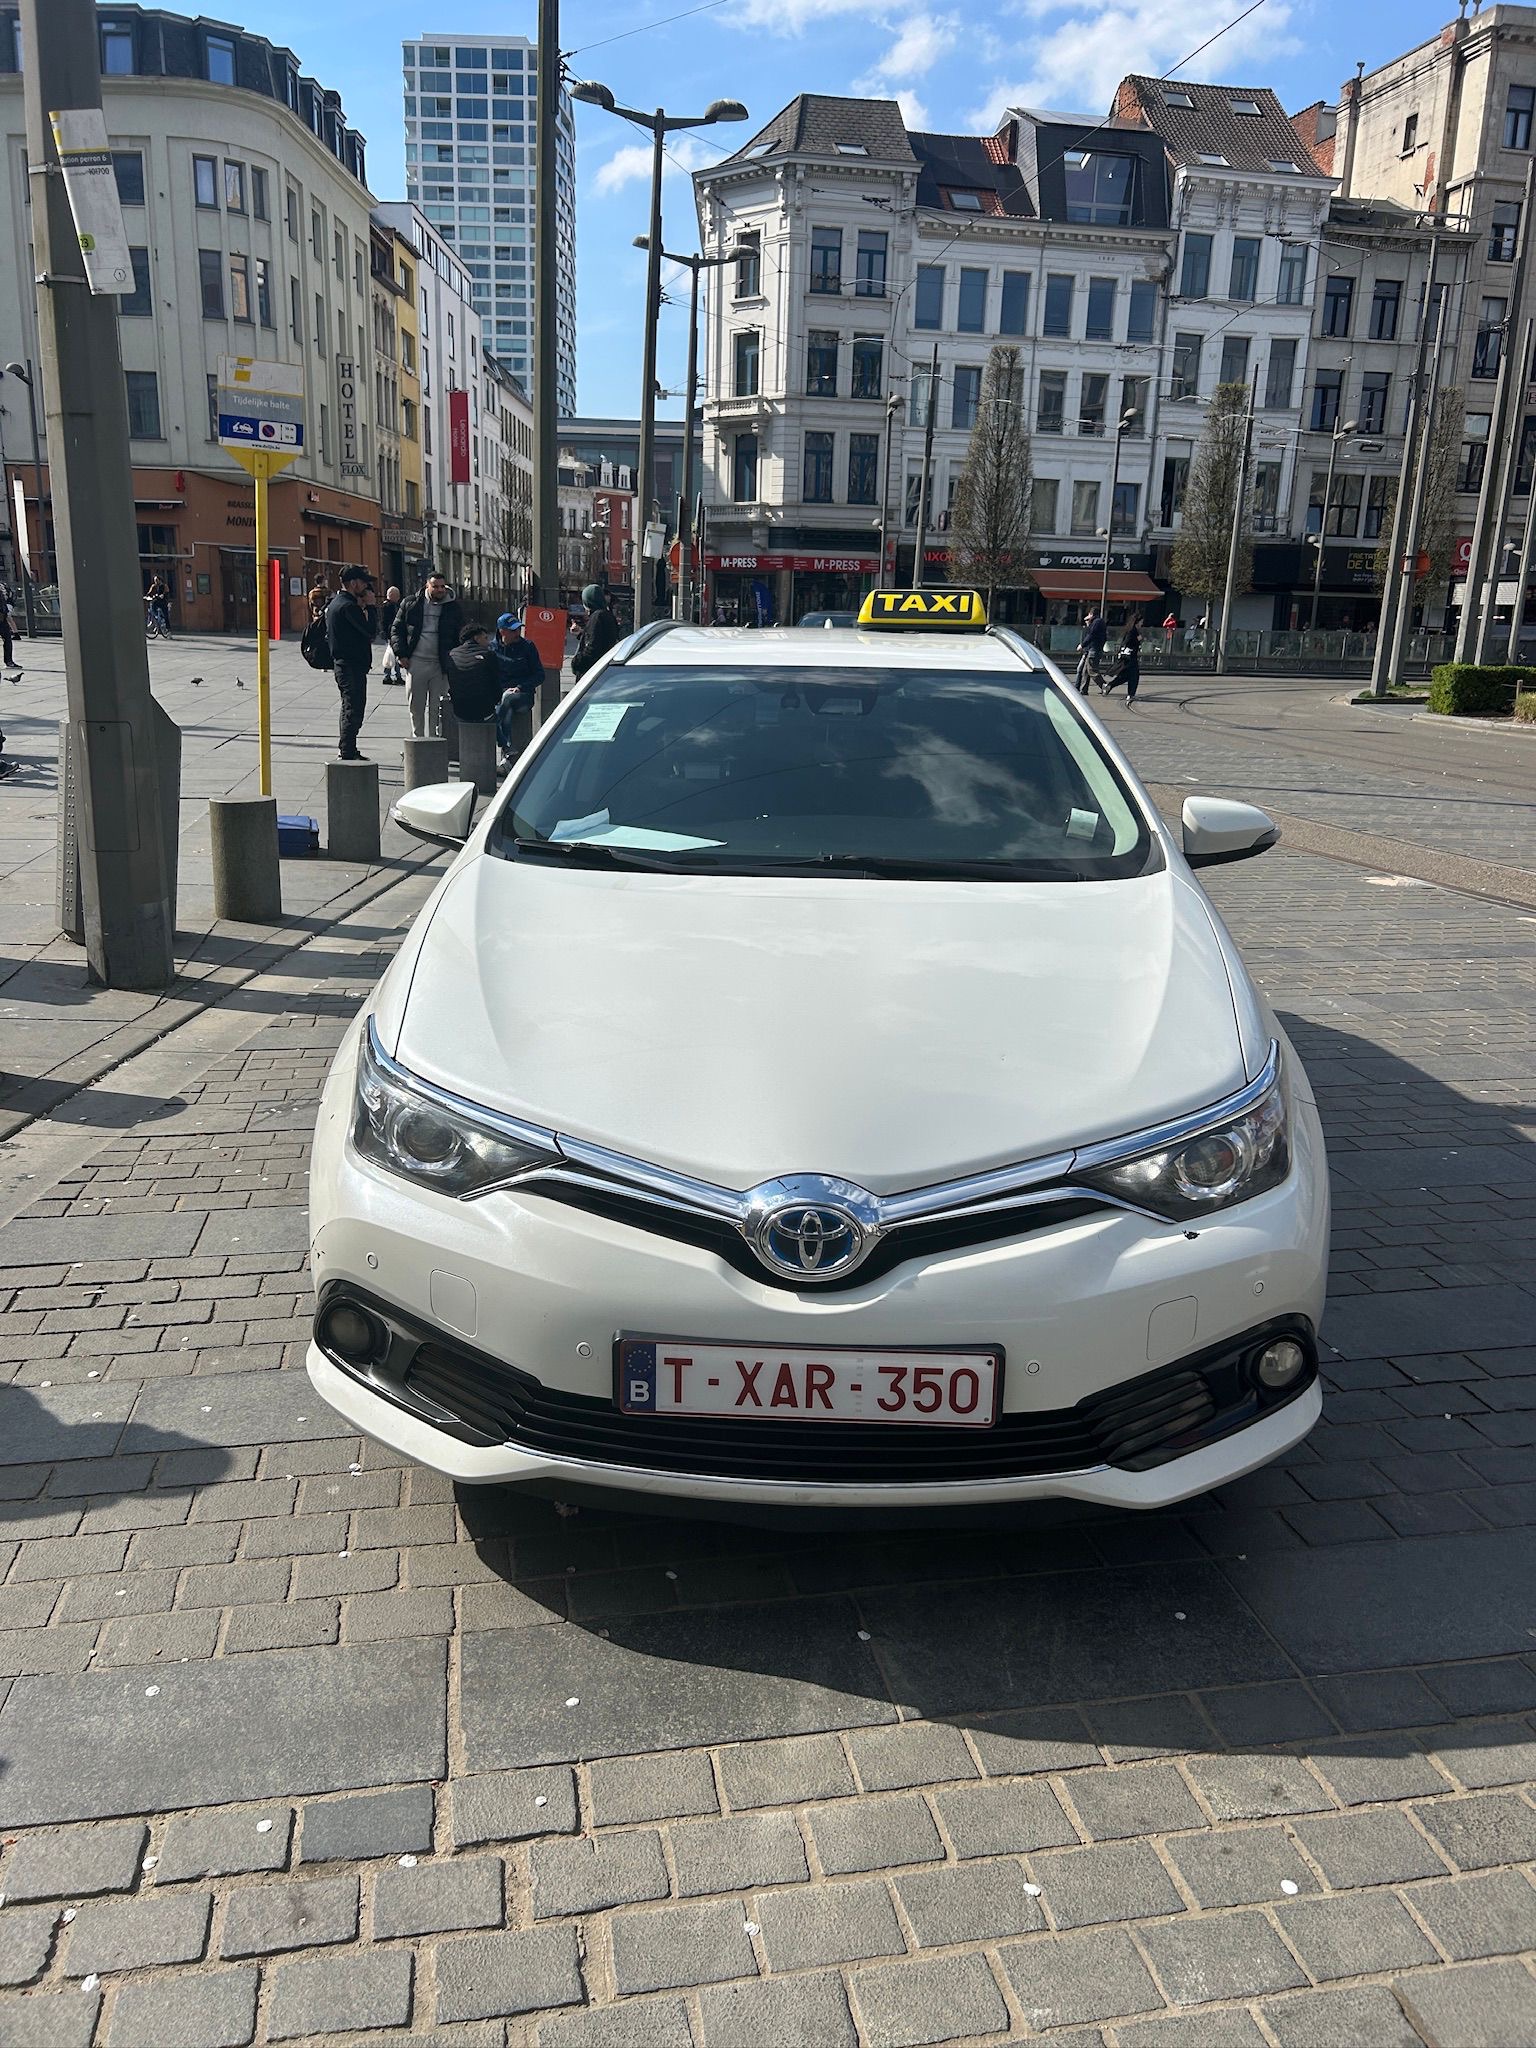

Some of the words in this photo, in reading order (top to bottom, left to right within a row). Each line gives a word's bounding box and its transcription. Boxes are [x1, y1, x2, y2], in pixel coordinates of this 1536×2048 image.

[80, 155, 101, 164] perron
[232, 396, 268, 408] Tijdelijke
[270, 400, 290, 410] halte
[340, 363, 354, 459] HOTEL
[342, 464, 365, 474] FLOX
[720, 558, 757, 568] M-PRESS
[814, 559, 860, 571] M-PRESS
[1346, 560, 1363, 570] DE
[877, 594, 970, 612] TAXI
[630, 1380, 650, 1402] B
[664, 1357, 980, 1414] T-XAR-350
